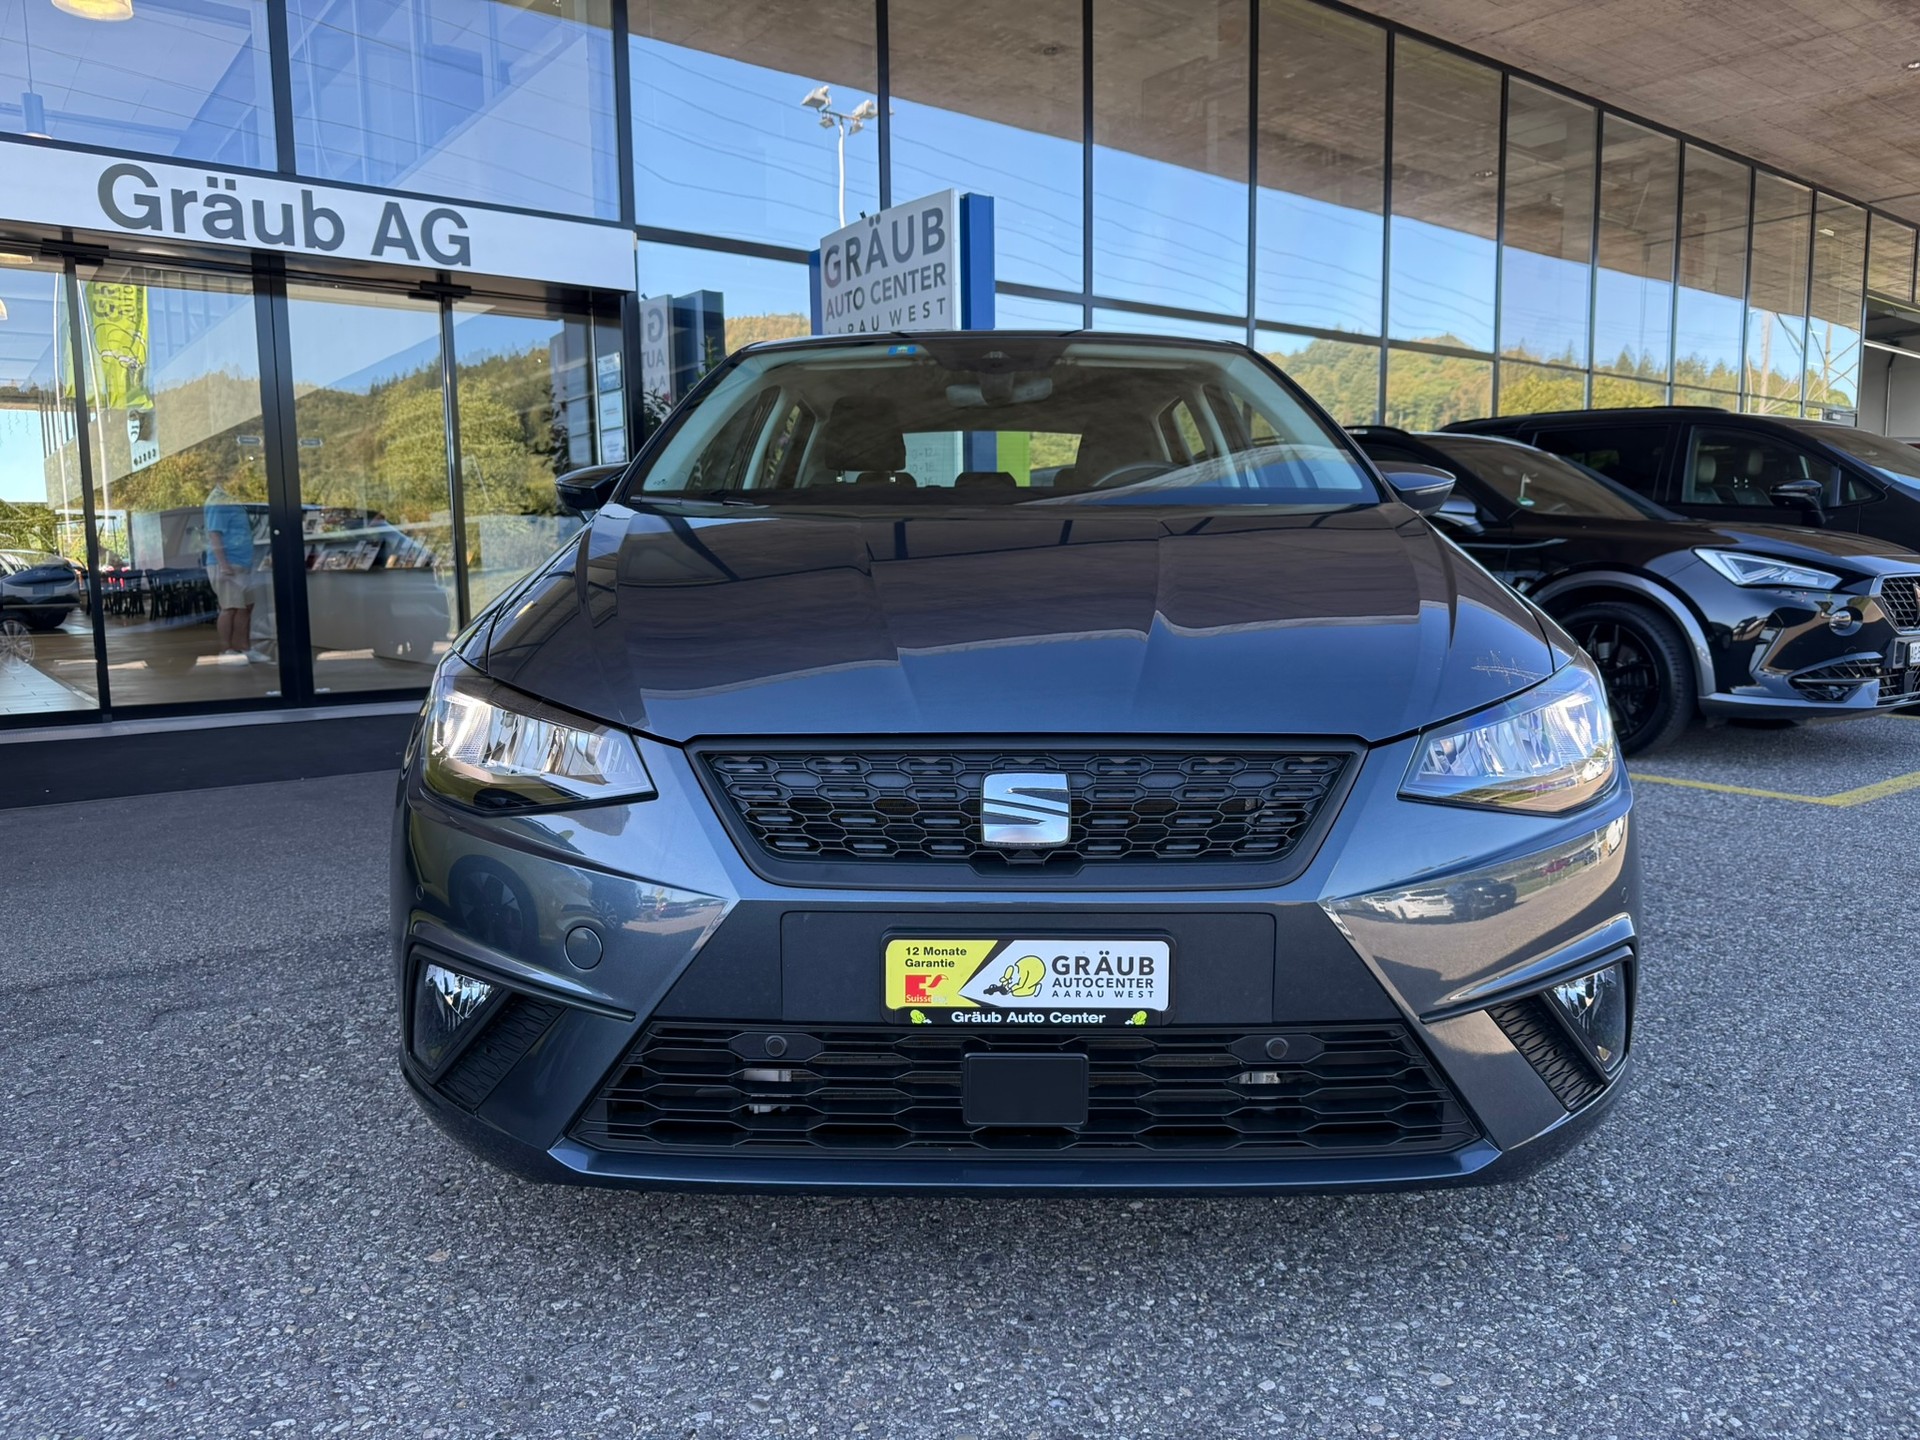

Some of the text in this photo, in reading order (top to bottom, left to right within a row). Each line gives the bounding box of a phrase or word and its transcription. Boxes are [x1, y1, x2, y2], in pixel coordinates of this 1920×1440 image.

[97, 163, 472, 267] Gräub AG
[824, 207, 946, 289] GRÄUB
[825, 262, 947, 322] AUTO CENTER
[889, 297, 947, 328] WEST
[905, 946, 967, 956] 12 Monate
[905, 958, 955, 968] Garantie
[1051, 950, 1155, 976] GRÄUB
[1052, 977, 1154, 989] AUTOCENTER
[1052, 990, 1154, 998] AARAU WEST
[951, 1011, 1106, 1024] Gräub Auto Center
